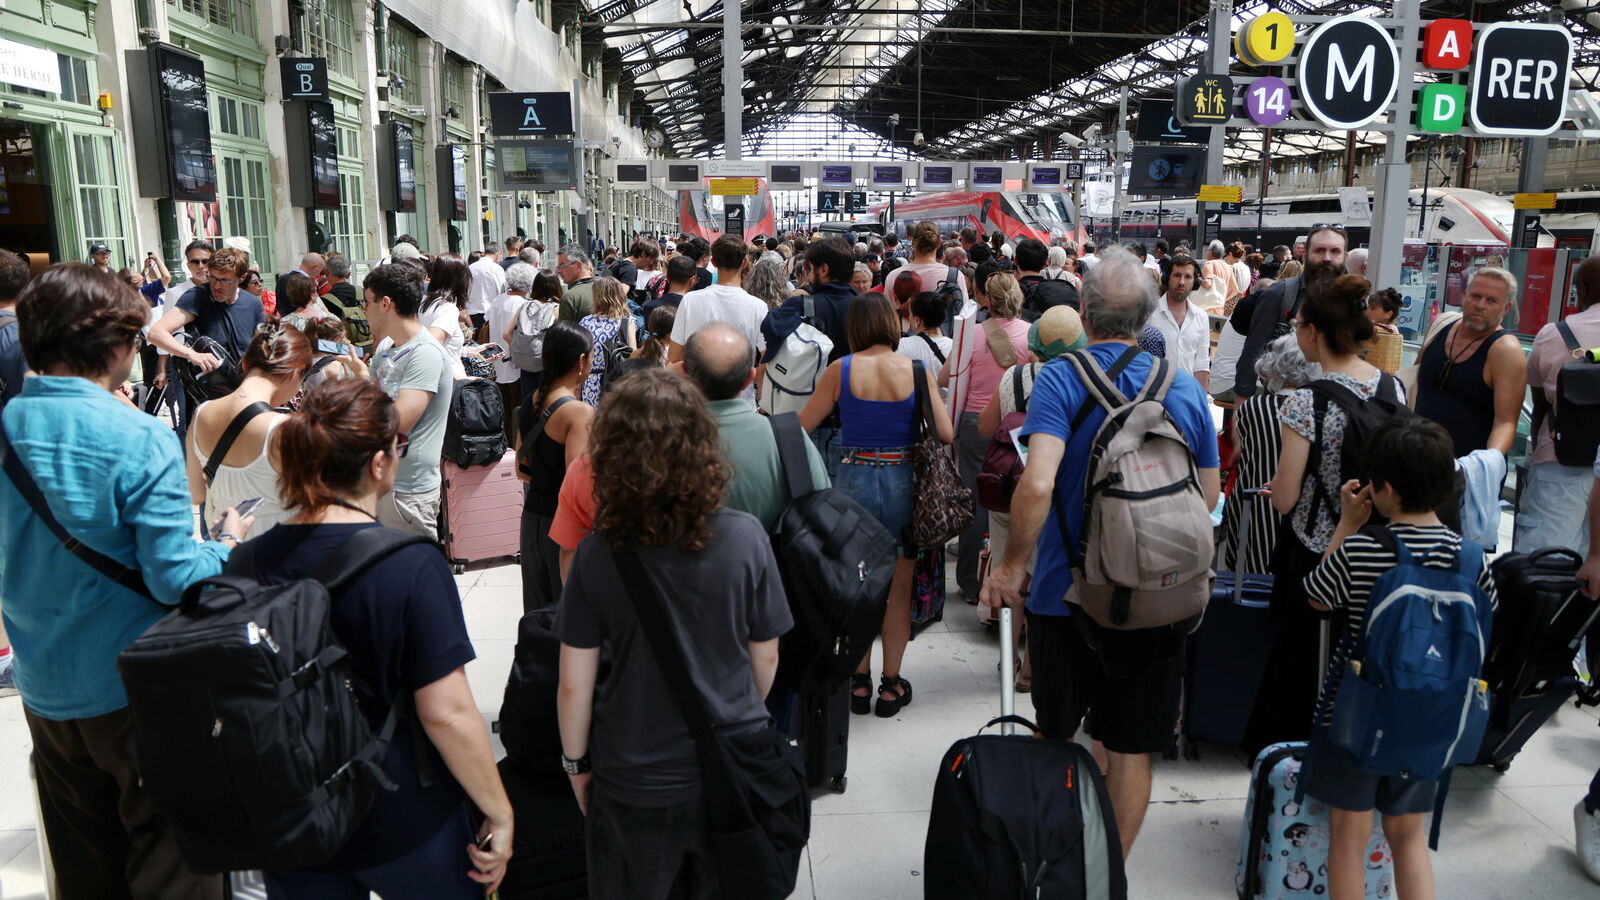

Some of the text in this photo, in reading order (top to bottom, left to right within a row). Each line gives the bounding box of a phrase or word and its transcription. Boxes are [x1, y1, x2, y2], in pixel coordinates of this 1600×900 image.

[1265, 23, 1278, 50] 1
[1438, 30, 1460, 58] A
[300, 74, 313, 92] B
[1325, 43, 1376, 102] M
[1487, 58, 1558, 100] RER
[1253, 87, 1285, 116] 14
[1433, 94, 1456, 121] D
[523, 106, 541, 126] A
[824, 198, 833, 208] A
